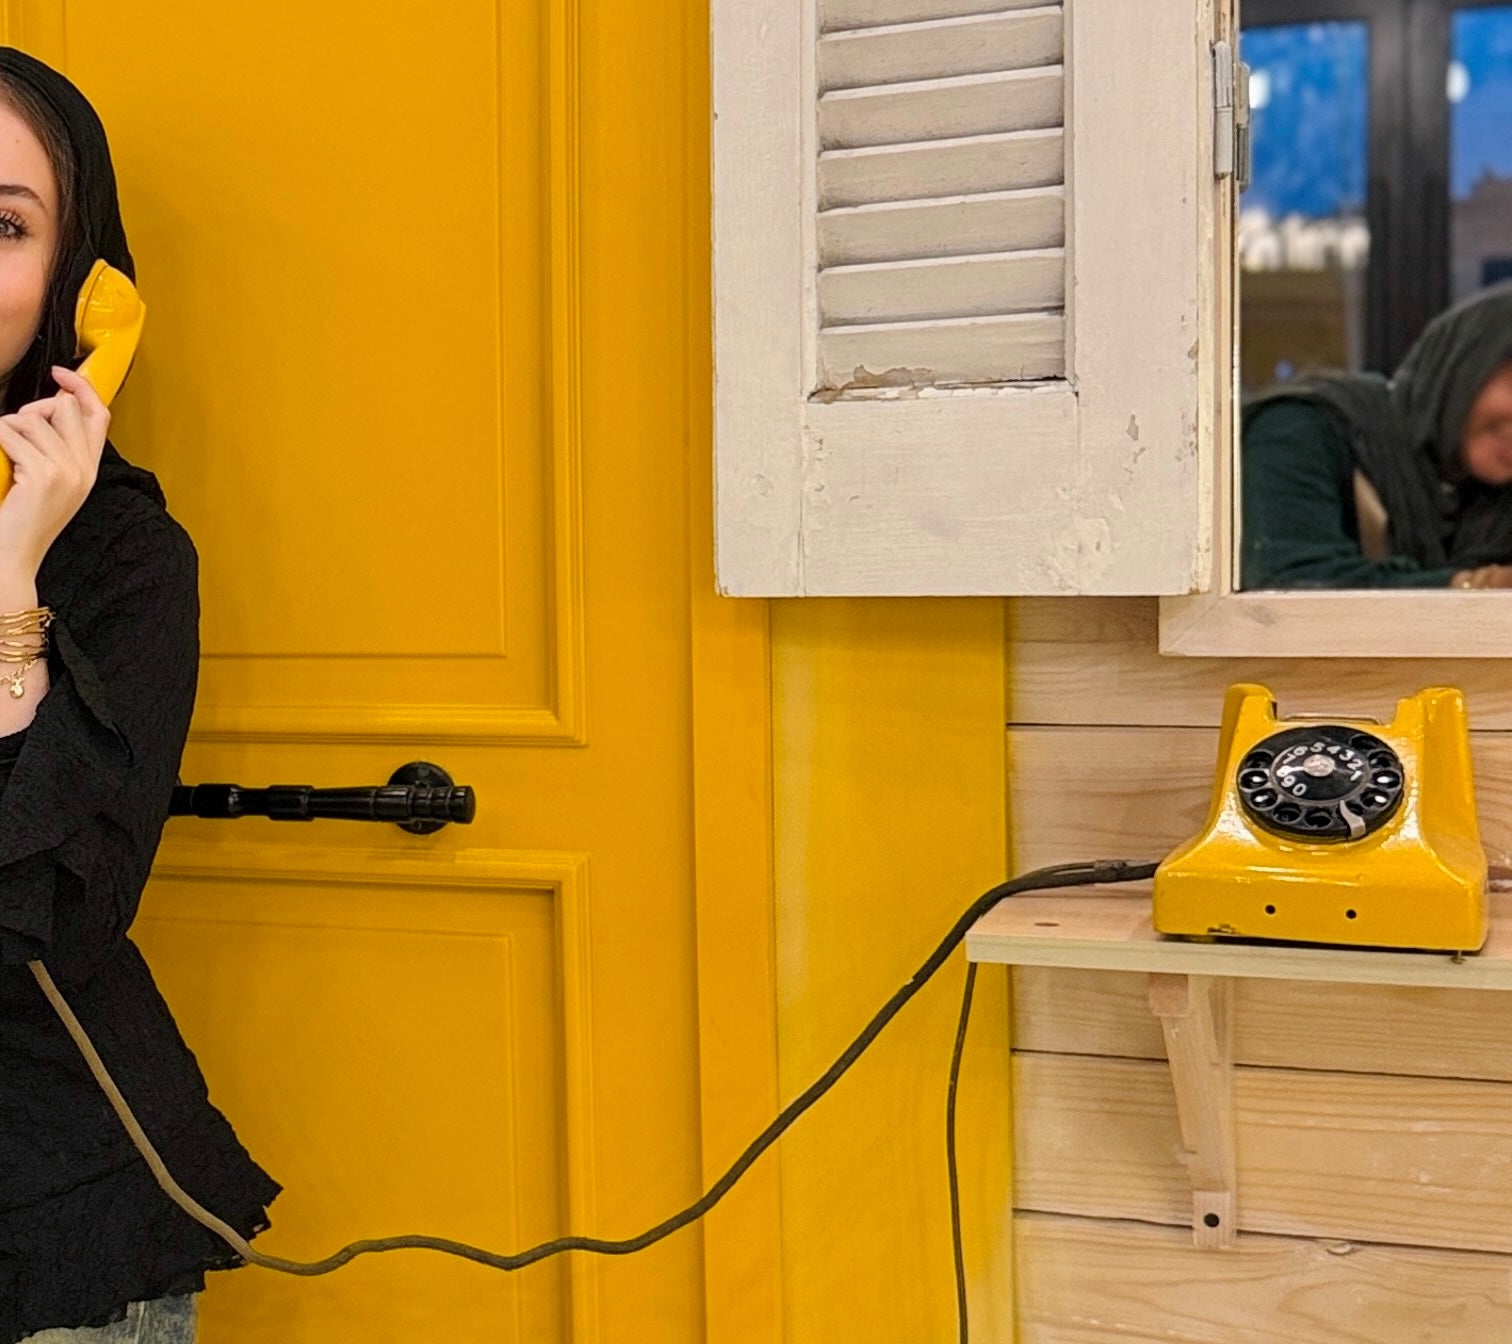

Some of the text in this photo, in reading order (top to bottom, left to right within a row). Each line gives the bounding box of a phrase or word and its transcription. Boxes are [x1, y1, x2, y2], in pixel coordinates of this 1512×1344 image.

[1293, 745, 1308, 756] 6
[1310, 741, 1326, 753] 5
[1338, 749, 1355, 761] 3
[1347, 758, 1363, 771] 2
[1280, 775, 1296, 788] 9
[1292, 783, 1307, 796] 0
